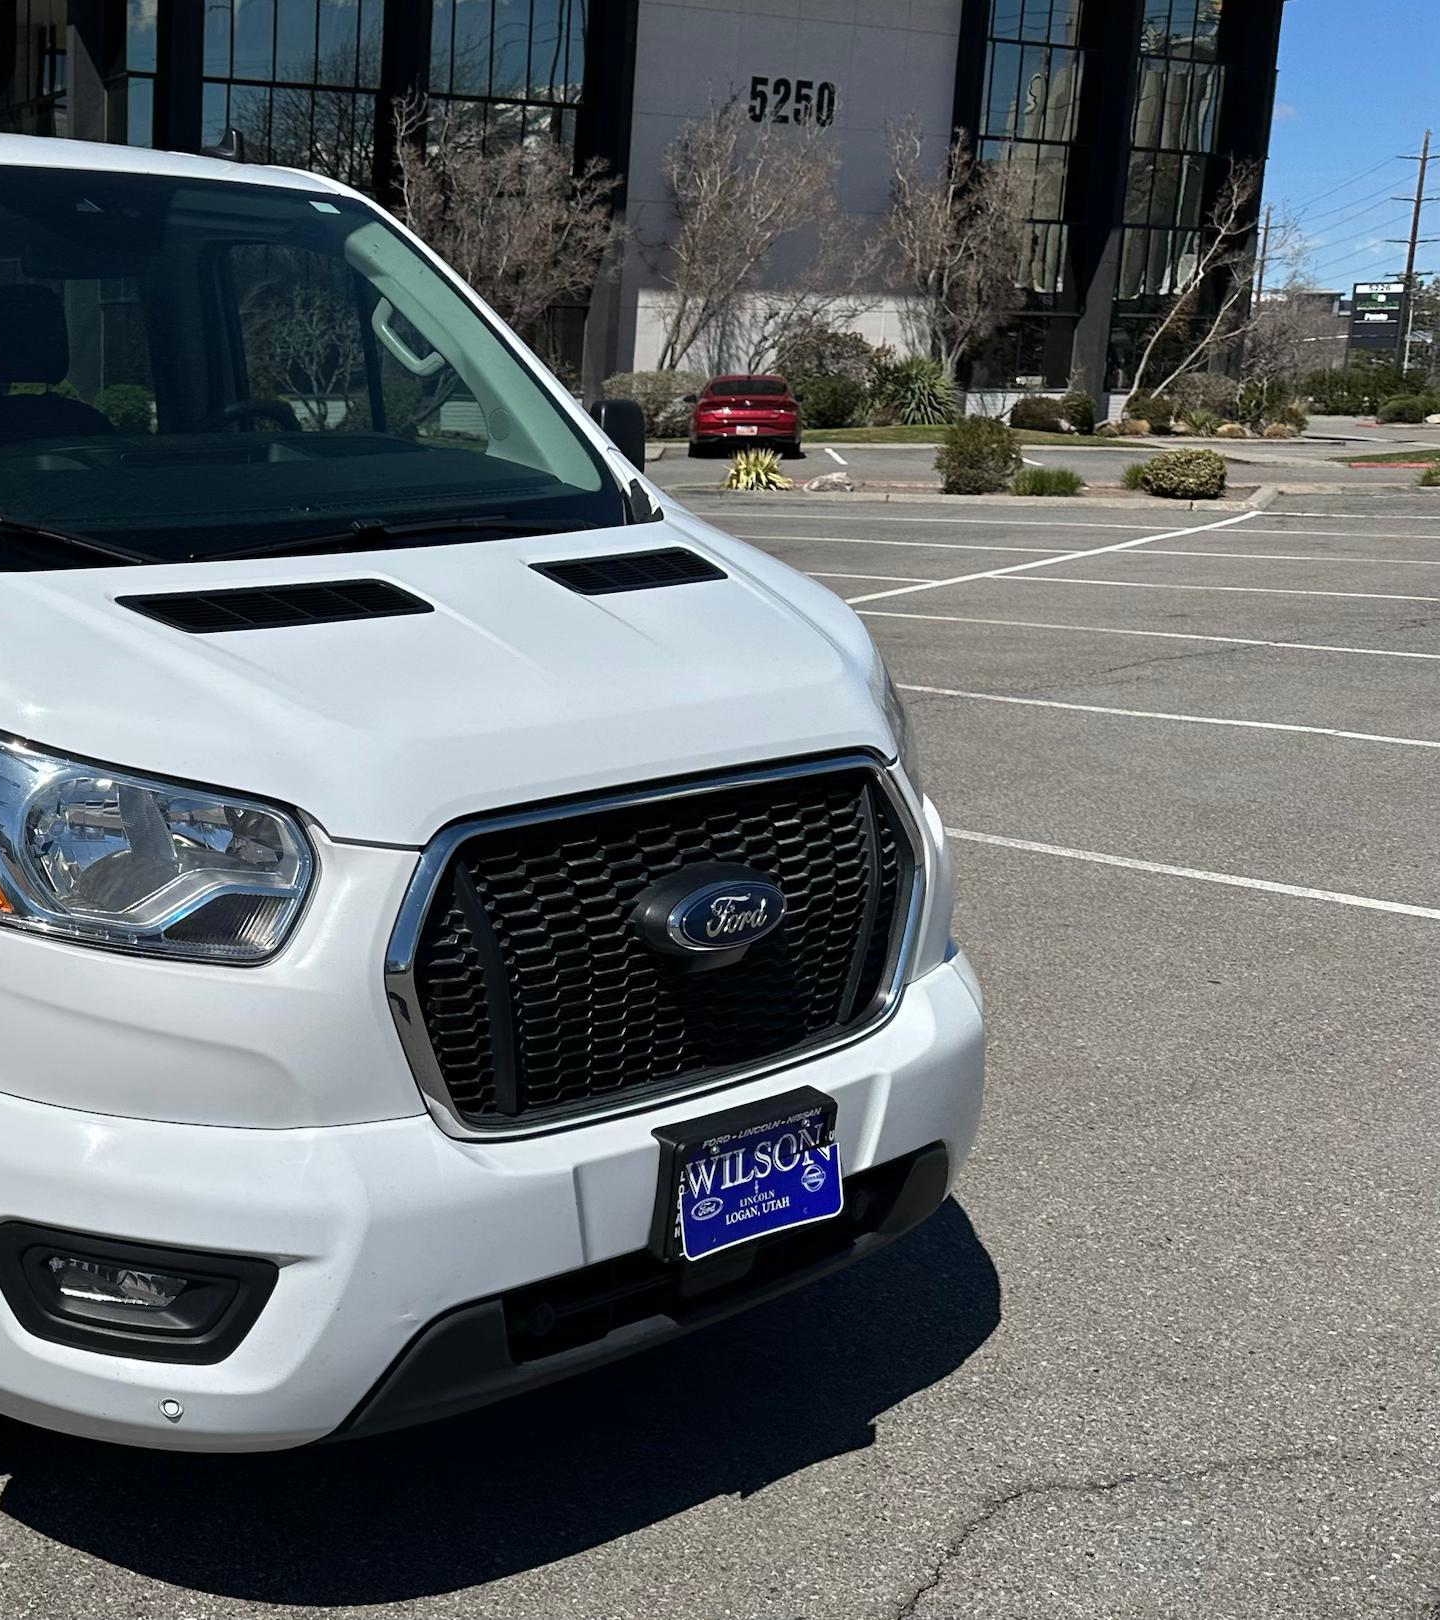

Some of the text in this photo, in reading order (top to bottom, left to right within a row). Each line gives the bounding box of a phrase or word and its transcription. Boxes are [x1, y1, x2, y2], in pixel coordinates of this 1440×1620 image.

[748, 76, 835, 127] 5250
[706, 893, 768, 938] Ford
[686, 1122, 831, 1199] WILSON
[725, 1196, 791, 1225] LOGAN, UTAH
[739, 1189, 775, 1208] LINCOLN
